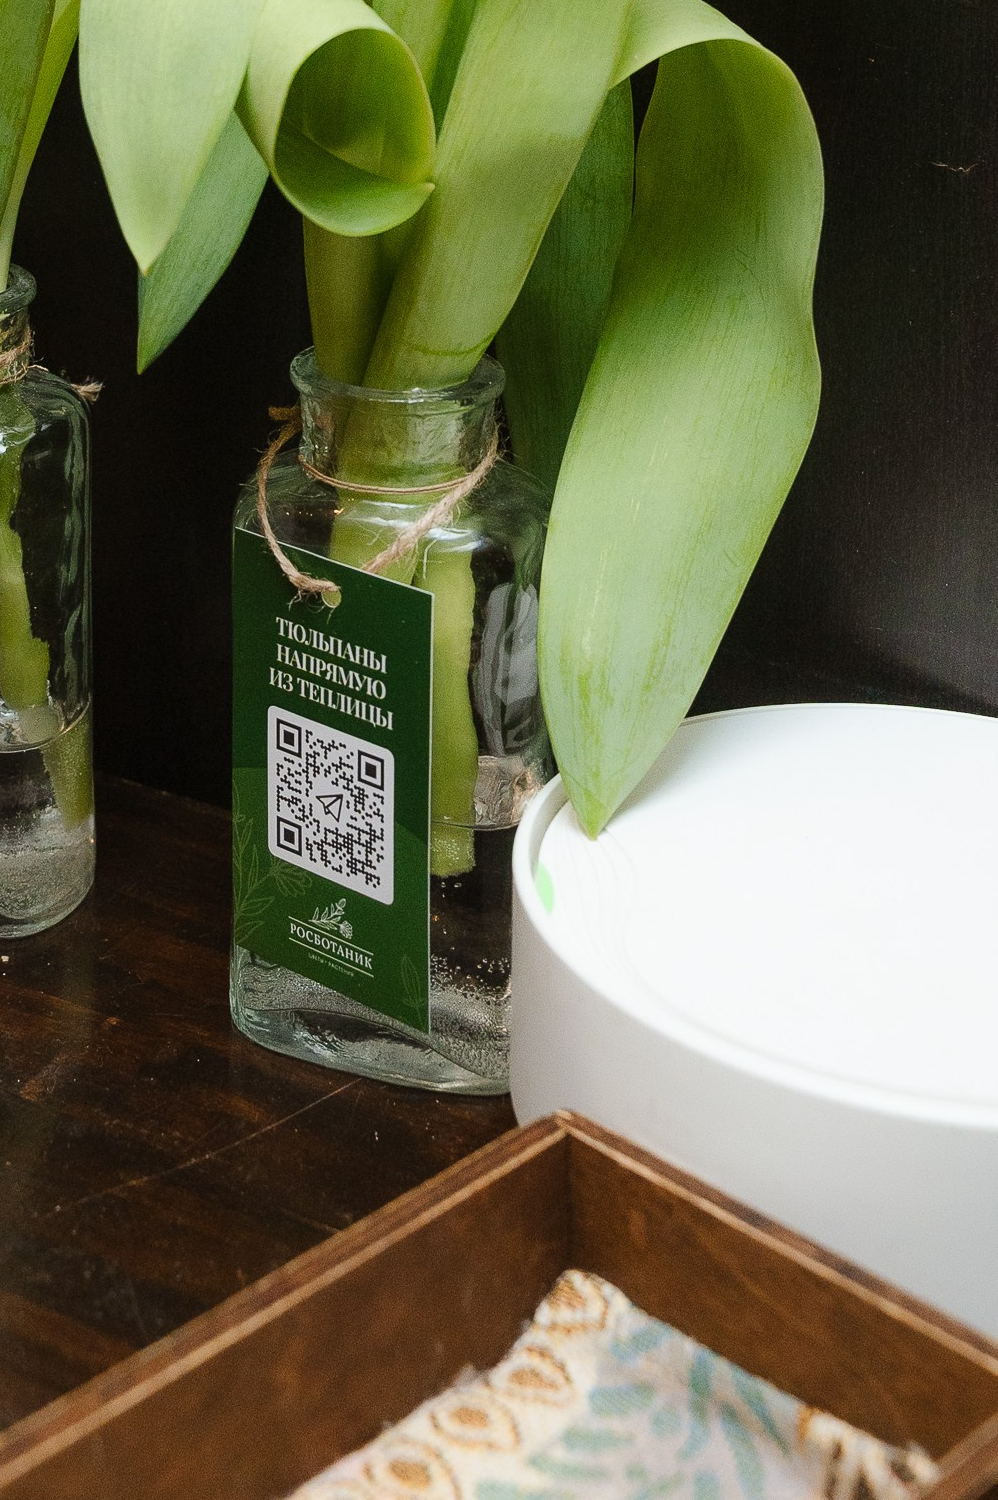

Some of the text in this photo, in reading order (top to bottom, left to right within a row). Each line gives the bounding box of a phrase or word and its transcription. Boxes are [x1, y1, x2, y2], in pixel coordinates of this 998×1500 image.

[275, 616, 387, 674] ТЮЛЬПАНЫ
[276, 643, 387, 700] НАПРЯМУЮ
[269, 667, 393, 731] ИЗ ТЕПЛИЦЫ
[290, 922, 373, 970] РОСБОТАНИК
